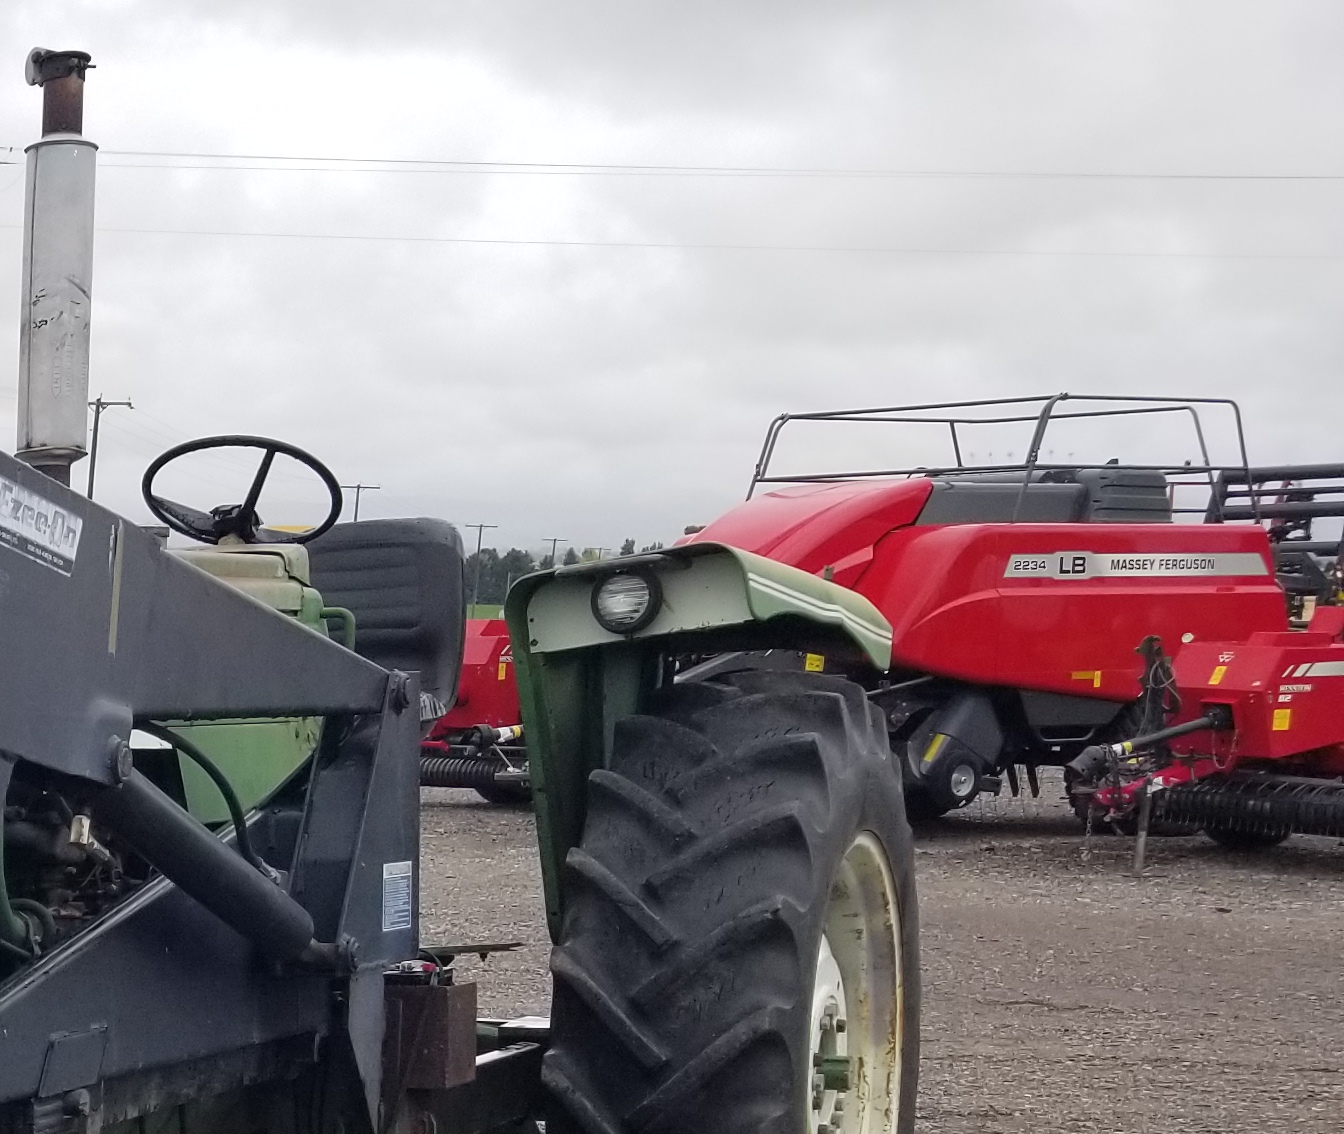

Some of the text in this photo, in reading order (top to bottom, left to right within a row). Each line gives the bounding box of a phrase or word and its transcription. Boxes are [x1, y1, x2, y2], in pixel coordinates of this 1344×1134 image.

[1013, 556, 1215, 574] 2234 LB MASSEY FERGUSON
